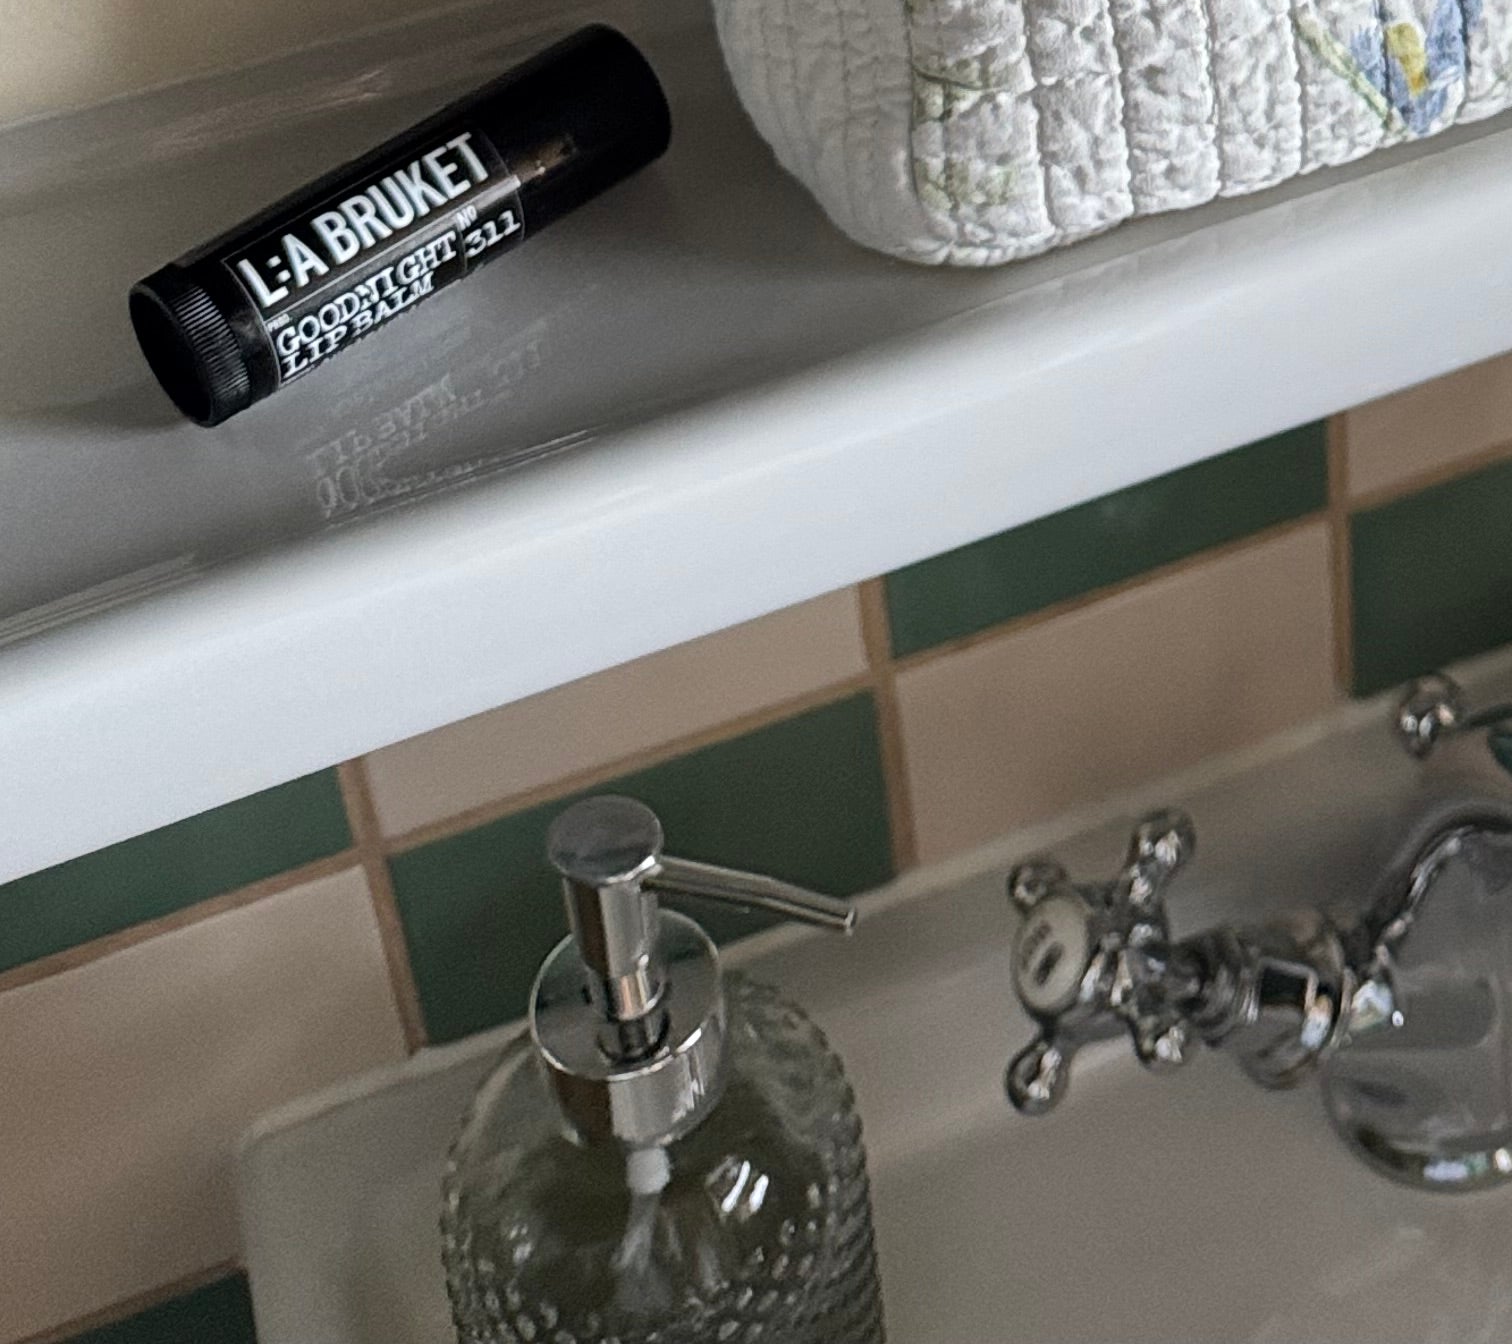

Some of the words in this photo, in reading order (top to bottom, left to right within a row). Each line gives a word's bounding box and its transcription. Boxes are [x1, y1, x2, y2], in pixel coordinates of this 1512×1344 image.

[235, 233, 330, 309] L:A
[309, 132, 489, 265] BRUKET
[465, 210, 521, 258] 311
[276, 230, 457, 356] GOODNIGHT
[281, 325, 348, 378] LIP
[351, 271, 435, 338] BALM
